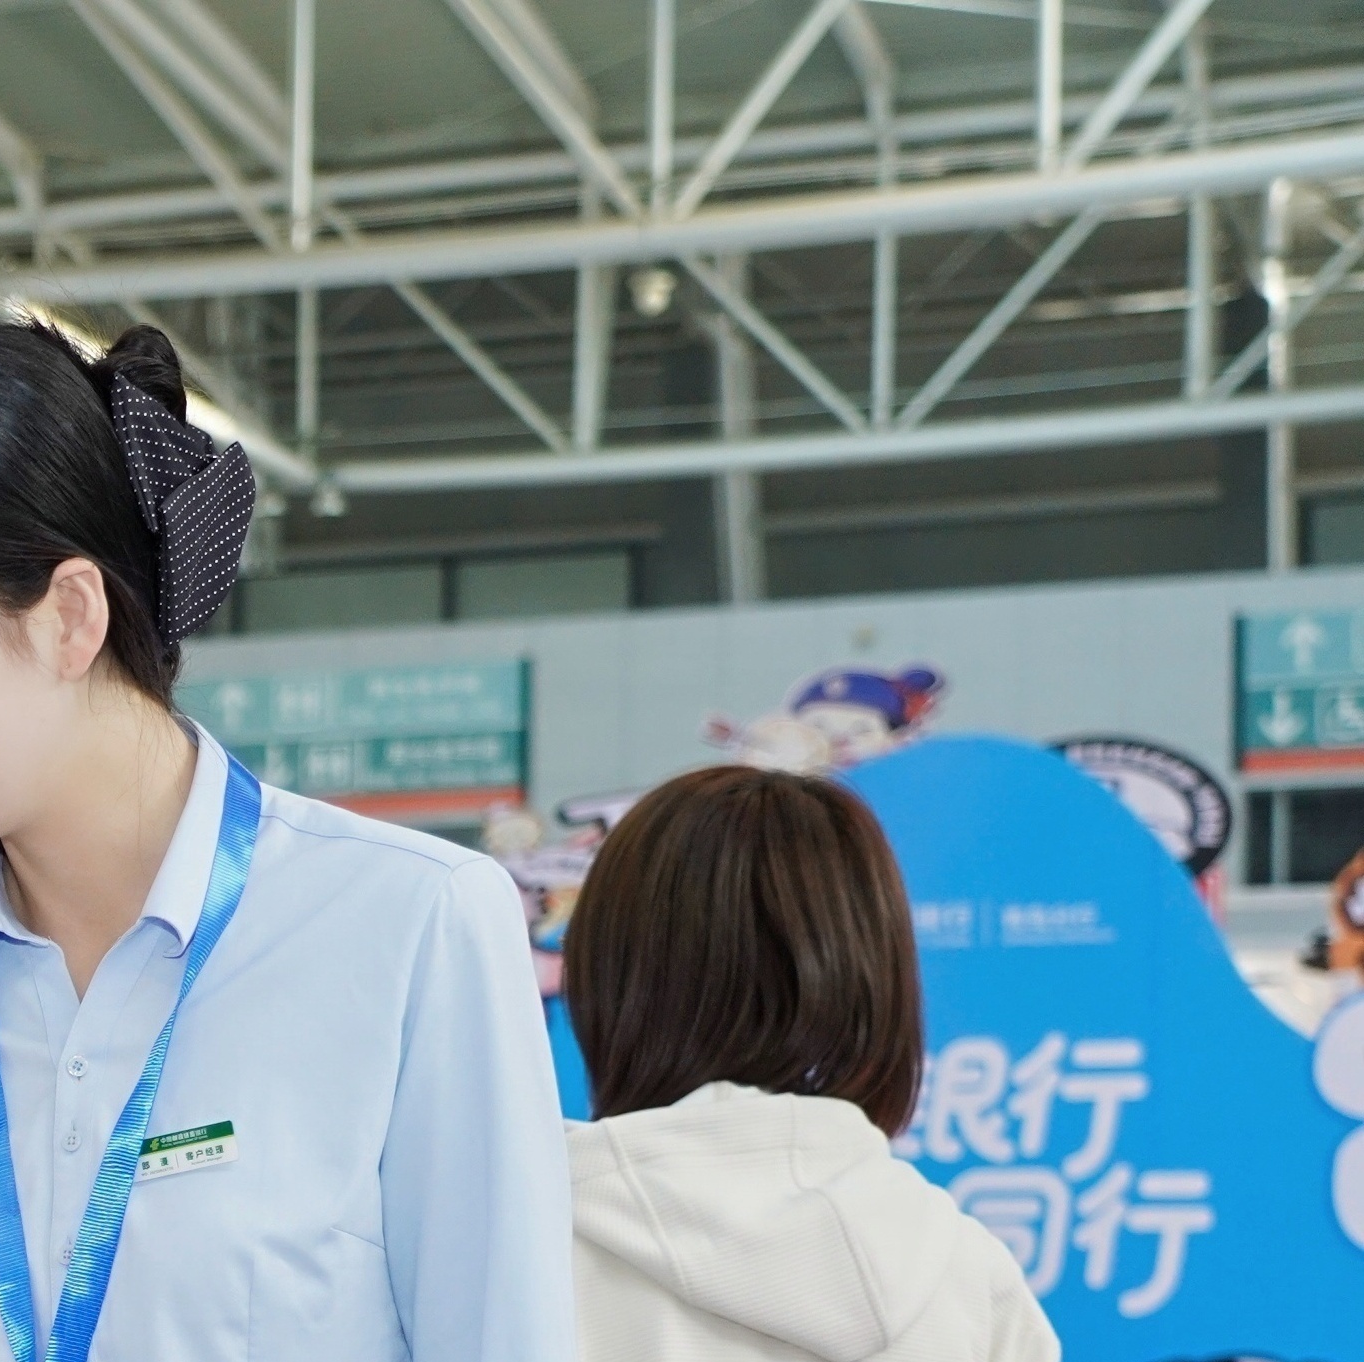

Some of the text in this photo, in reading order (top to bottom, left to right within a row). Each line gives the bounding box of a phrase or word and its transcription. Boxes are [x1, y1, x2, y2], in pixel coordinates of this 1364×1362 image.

[186, 1145, 224, 1160] 客户经理
[947, 1161, 1217, 1319] 同行
